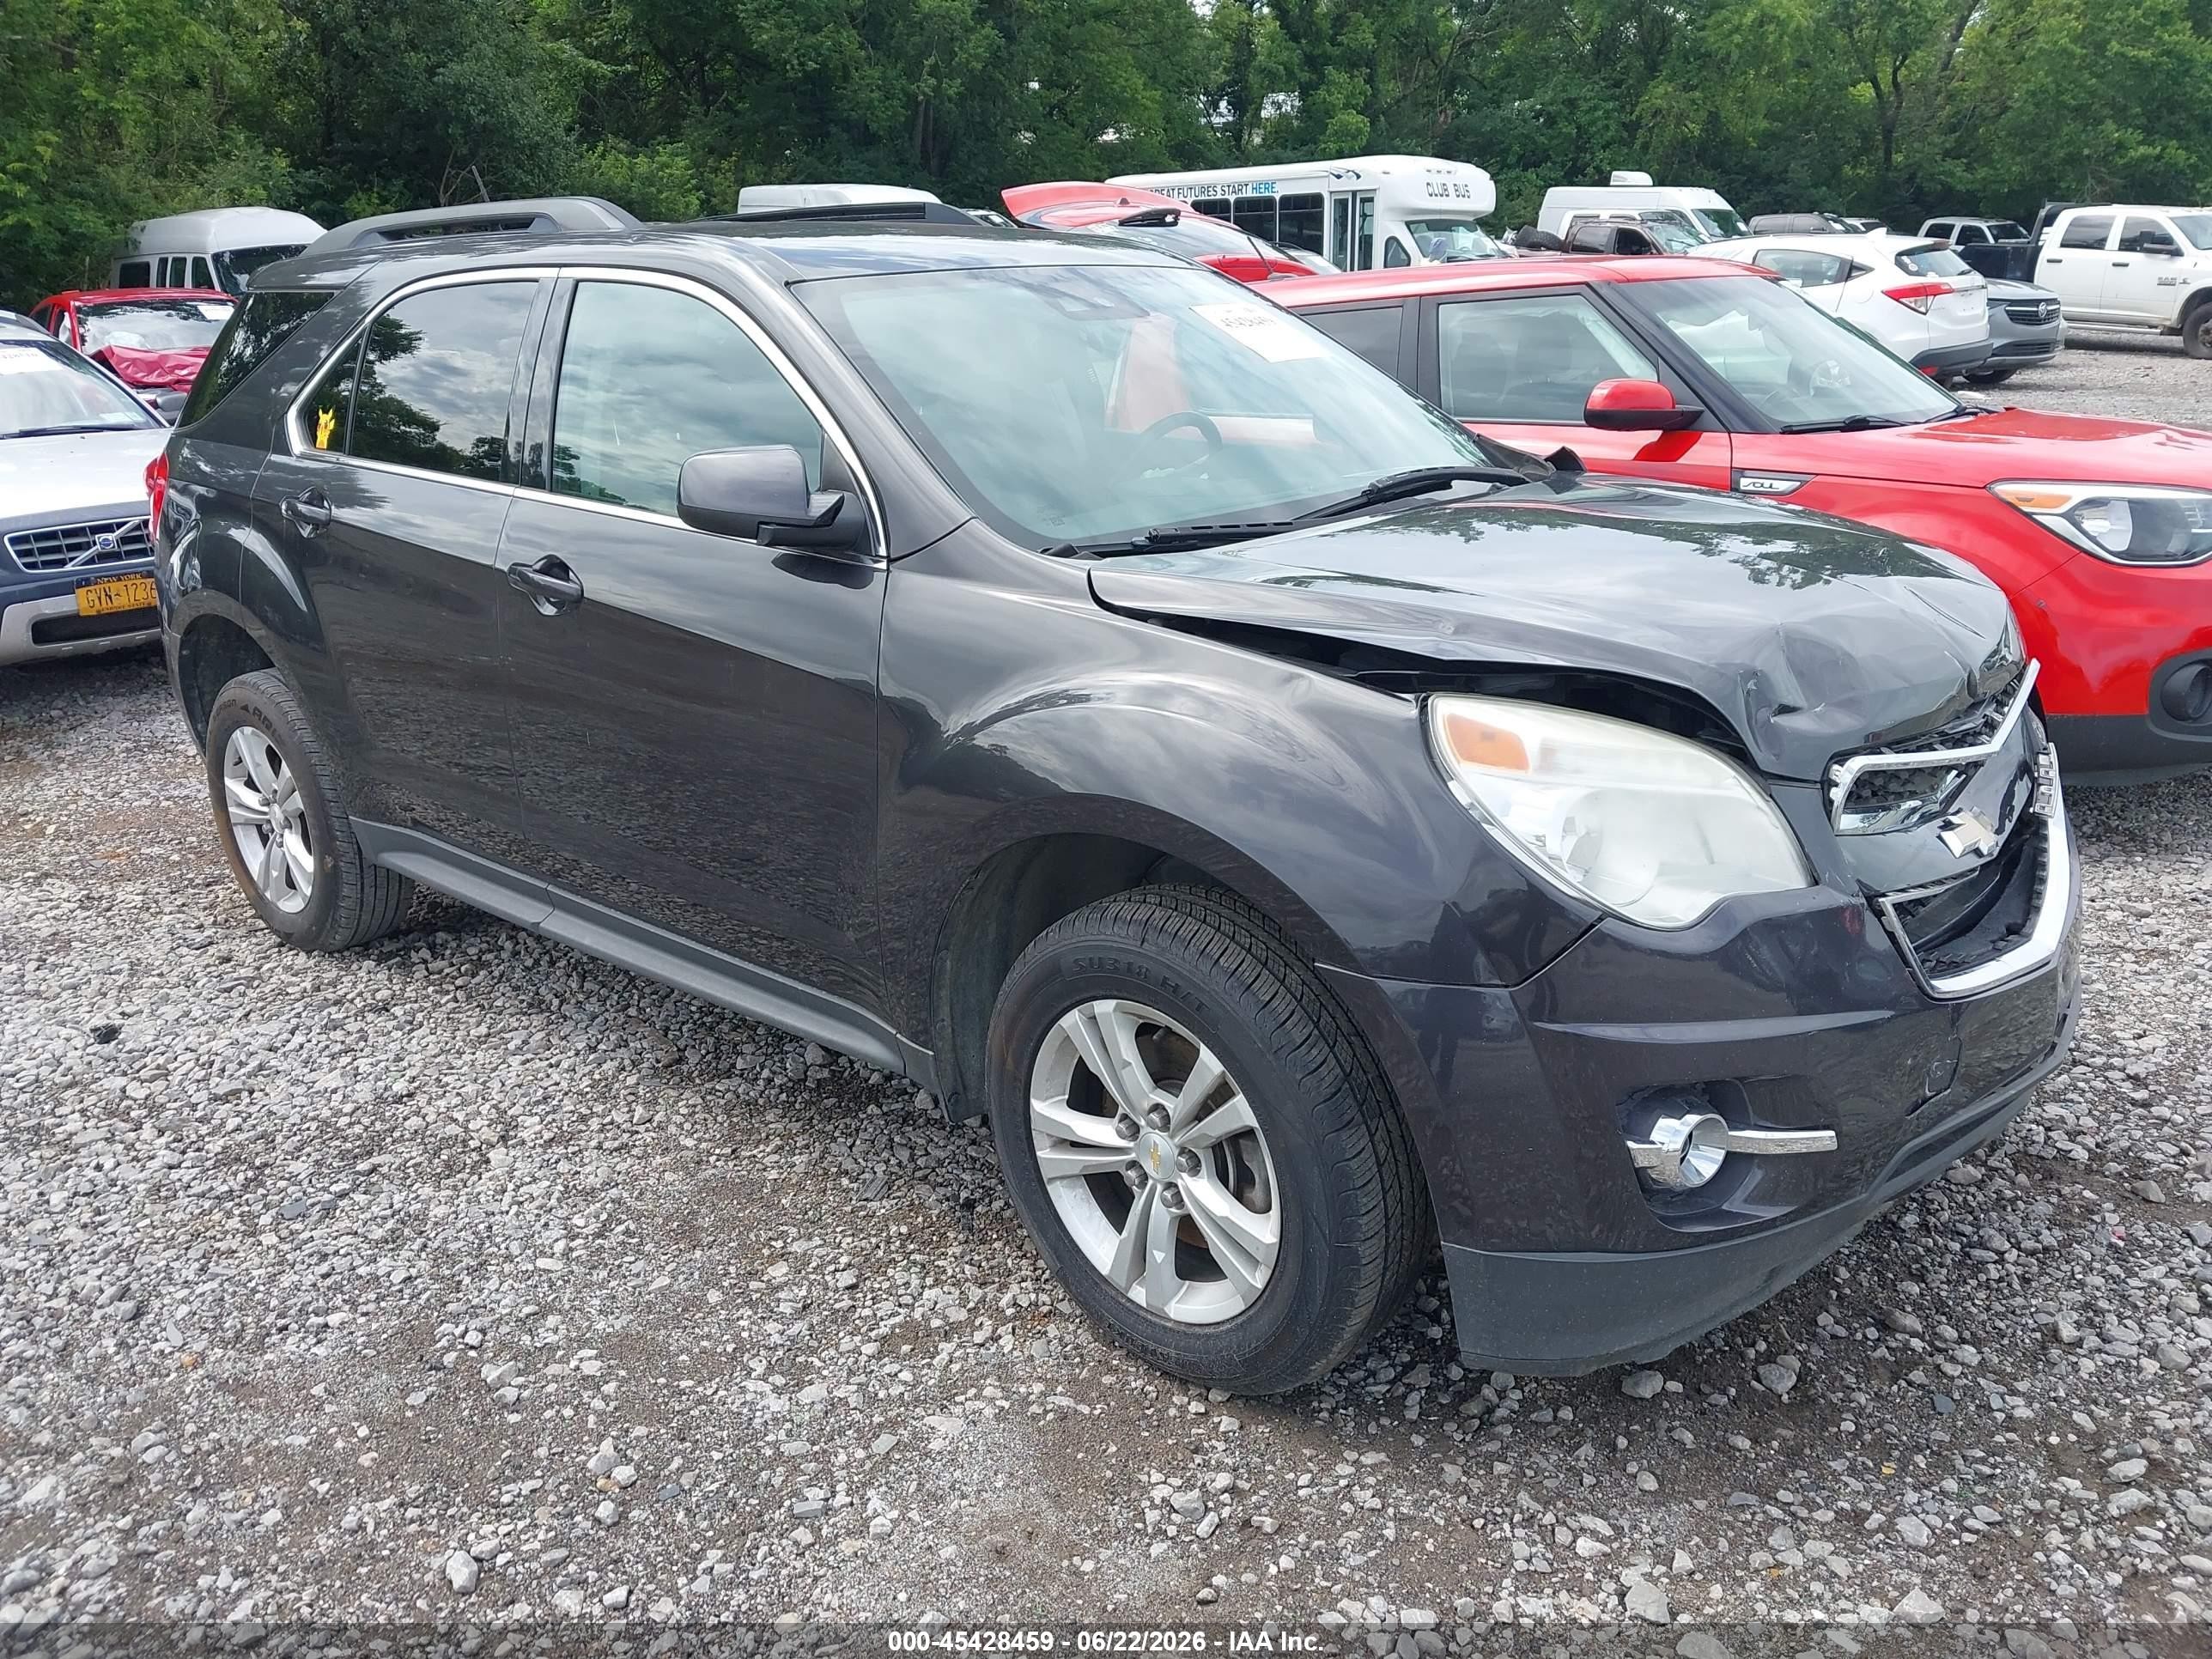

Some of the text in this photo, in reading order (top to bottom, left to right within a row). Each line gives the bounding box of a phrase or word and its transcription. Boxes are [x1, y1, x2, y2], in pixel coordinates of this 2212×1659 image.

[1177, 185, 1218, 198] FUTURES
[1220, 184, 1249, 196] START
[1251, 182, 1279, 194] HERE.
[1426, 181, 1470, 198] CLUB BUS
[96, 571, 143, 585] NEW YORK
[1073, 956, 1210, 1012] SU318 H/T
